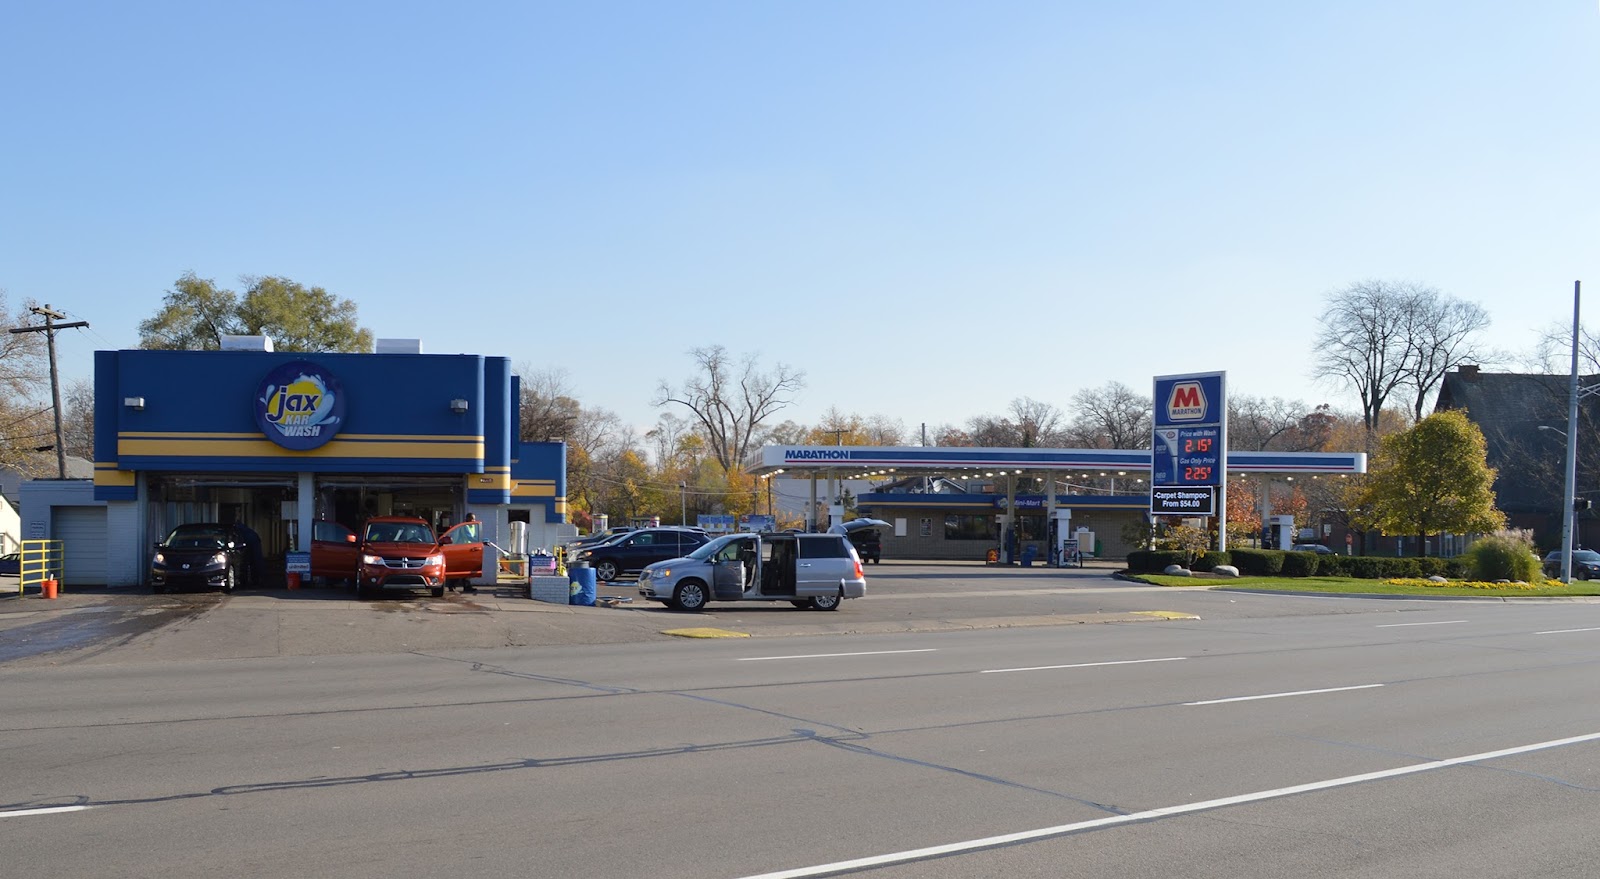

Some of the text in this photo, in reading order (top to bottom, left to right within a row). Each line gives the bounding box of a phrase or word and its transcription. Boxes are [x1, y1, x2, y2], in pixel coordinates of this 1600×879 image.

[1173, 387, 1200, 407] M
[265, 386, 320, 423] jax
[285, 414, 309, 425] KAR
[284, 425, 321, 437] WASH
[785, 450, 849, 459] MARATHON
[1180, 500, 1201, 508] $54.00
